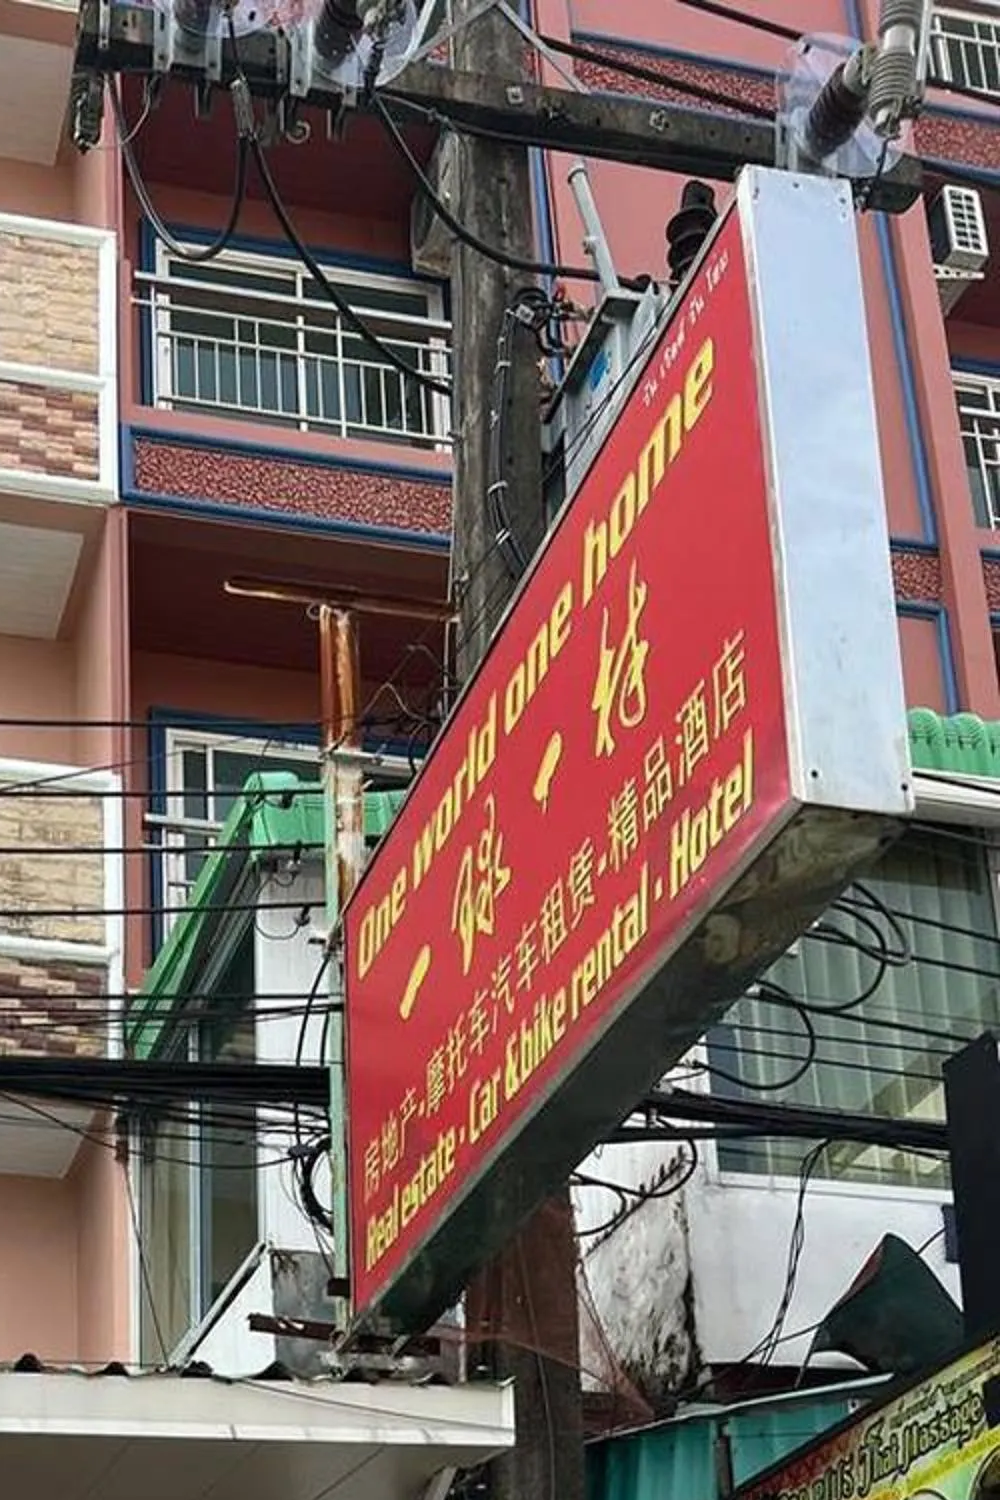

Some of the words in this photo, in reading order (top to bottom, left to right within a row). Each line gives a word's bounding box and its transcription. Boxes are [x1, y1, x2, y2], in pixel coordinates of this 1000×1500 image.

[357, 865, 407, 979] One
[412, 690, 497, 890] world
[503, 580, 573, 736] one
[581, 336, 714, 607] home
[365, 1184, 399, 1271] Real
[400, 1126, 456, 1228] estate
[468, 1066, 501, 1144] Car
[570, 861, 648, 1021] rental
[668, 727, 753, 900] Hotel
[899, 1390, 987, 1474] Massage
